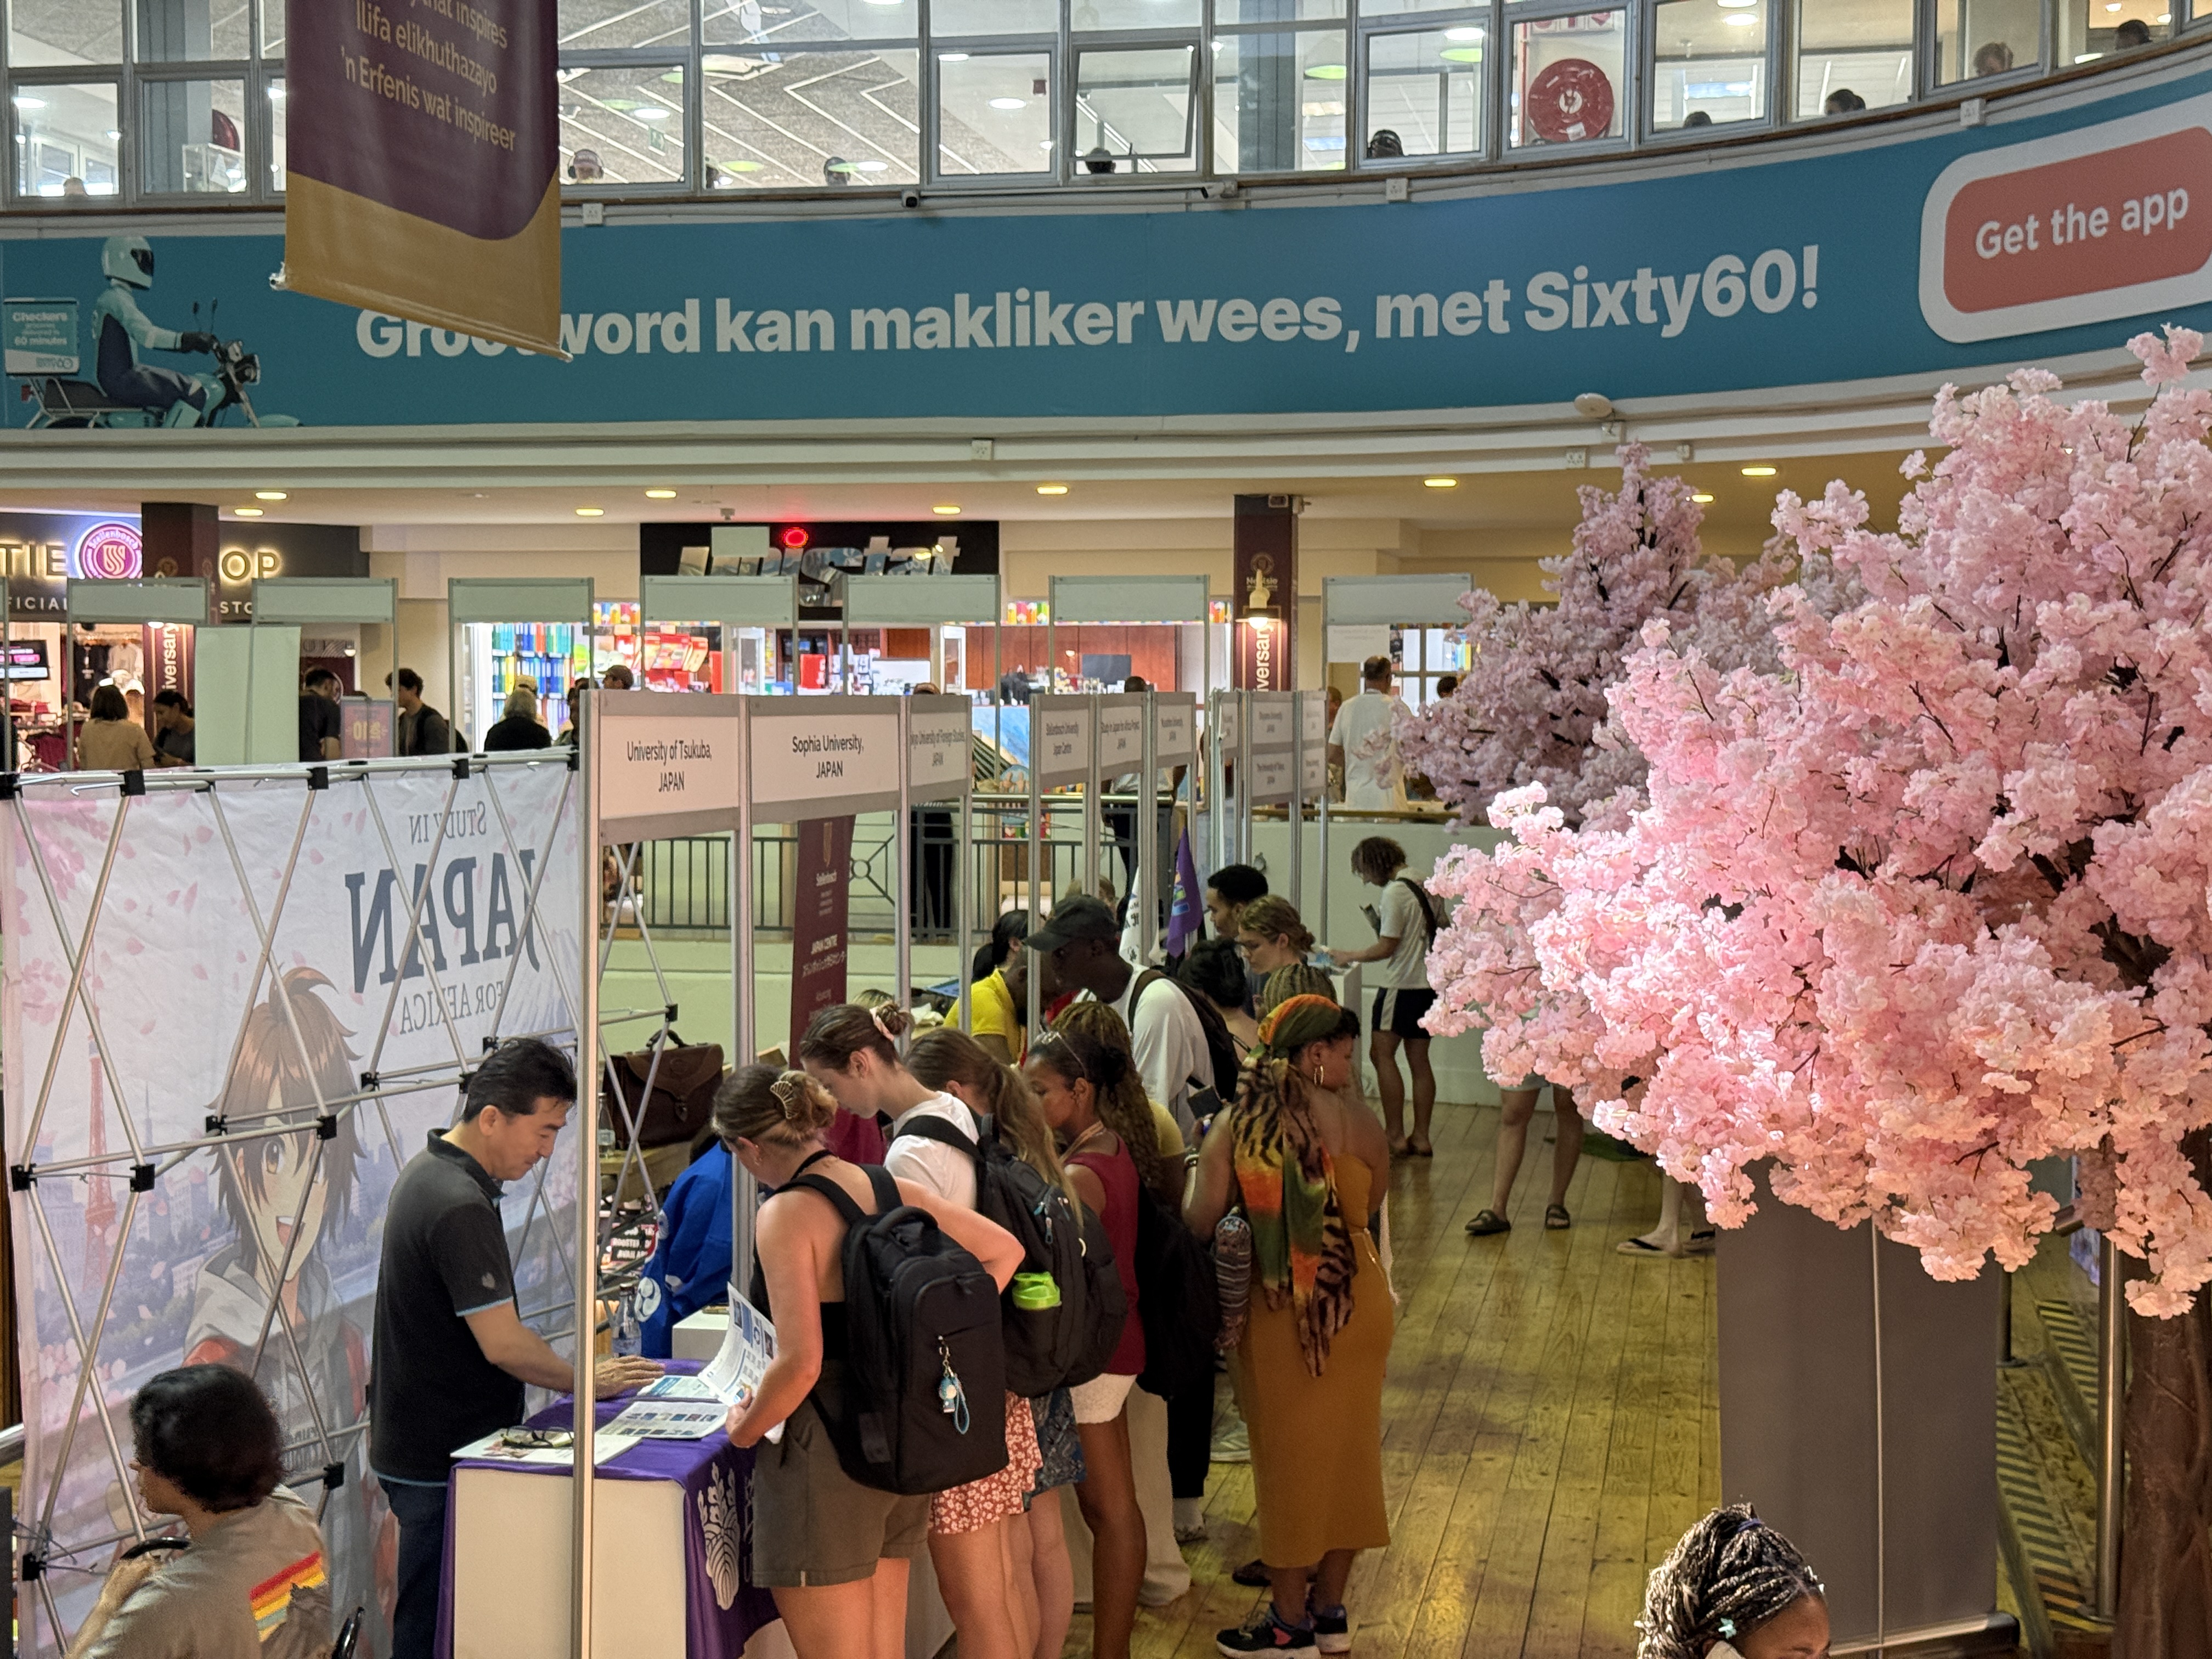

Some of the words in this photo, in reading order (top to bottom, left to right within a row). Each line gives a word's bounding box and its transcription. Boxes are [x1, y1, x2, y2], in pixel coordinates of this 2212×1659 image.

[456, 0, 508, 49] inspires
[356, 1, 391, 43] Ilifa
[396, 20, 497, 98] elikhuthazayo
[359, 55, 420, 109] Erfenis
[422, 89, 452, 123] wat
[455, 97, 516, 151] inspireer
[1976, 215, 2039, 259] Get
[2051, 203, 2109, 246] the
[2120, 187, 2189, 236] app
[356, 298, 701, 358] Groword
[715, 297, 835, 352] kan
[850, 287, 1145, 350] makliker
[1155, 295, 1361, 353] wees,
[1375, 279, 1511, 338] met
[1524, 245, 1819, 338] Sixty60!
[627, 740, 668, 766] University
[669, 739, 678, 760] of
[679, 738, 712, 761] Tsukuba,
[792, 734, 821, 758] Sophia
[822, 733, 864, 755] University,
[816, 760, 843, 778] JAPAN
[658, 770, 685, 792] JAPAN
